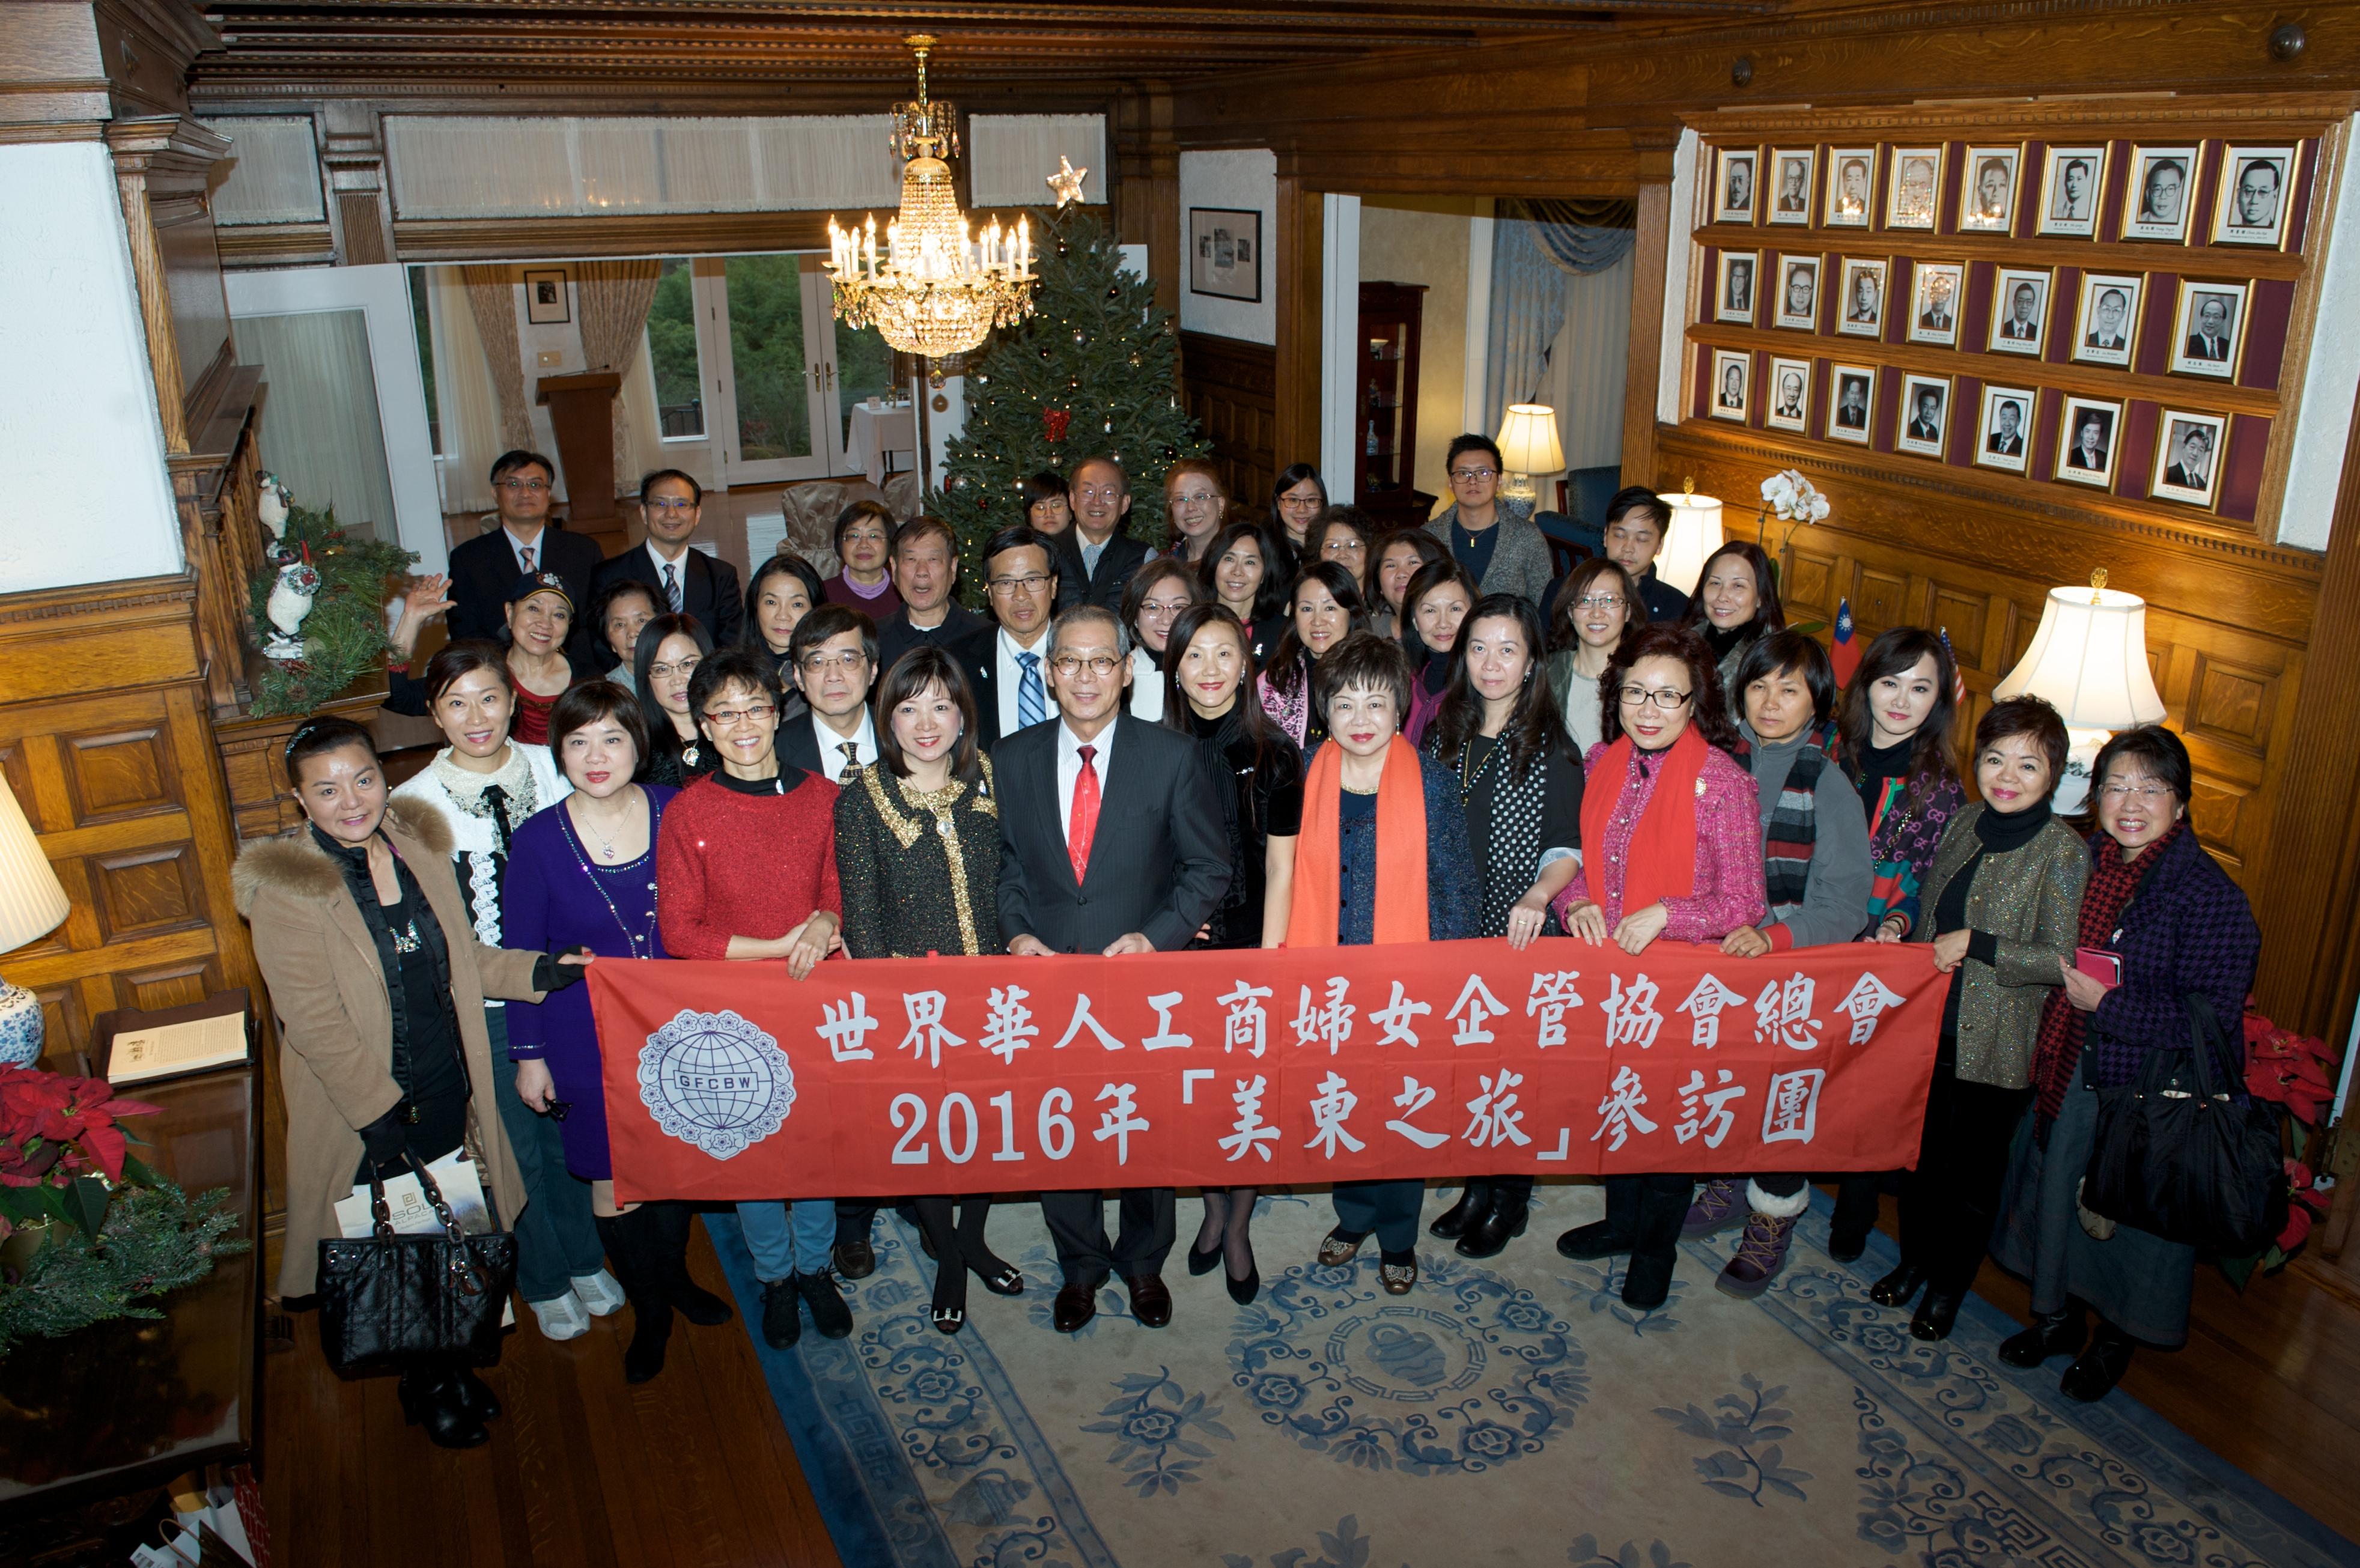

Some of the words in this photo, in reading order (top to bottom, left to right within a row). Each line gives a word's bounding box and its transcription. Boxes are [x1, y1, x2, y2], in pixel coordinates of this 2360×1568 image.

[815, 970, 1906, 1069] 世界華人工商婦女企管協會總會
[680, 1075, 750, 1089] GFCBW
[392, 1203, 434, 1220] SOL
[395, 1209, 435, 1226] ALPACA
